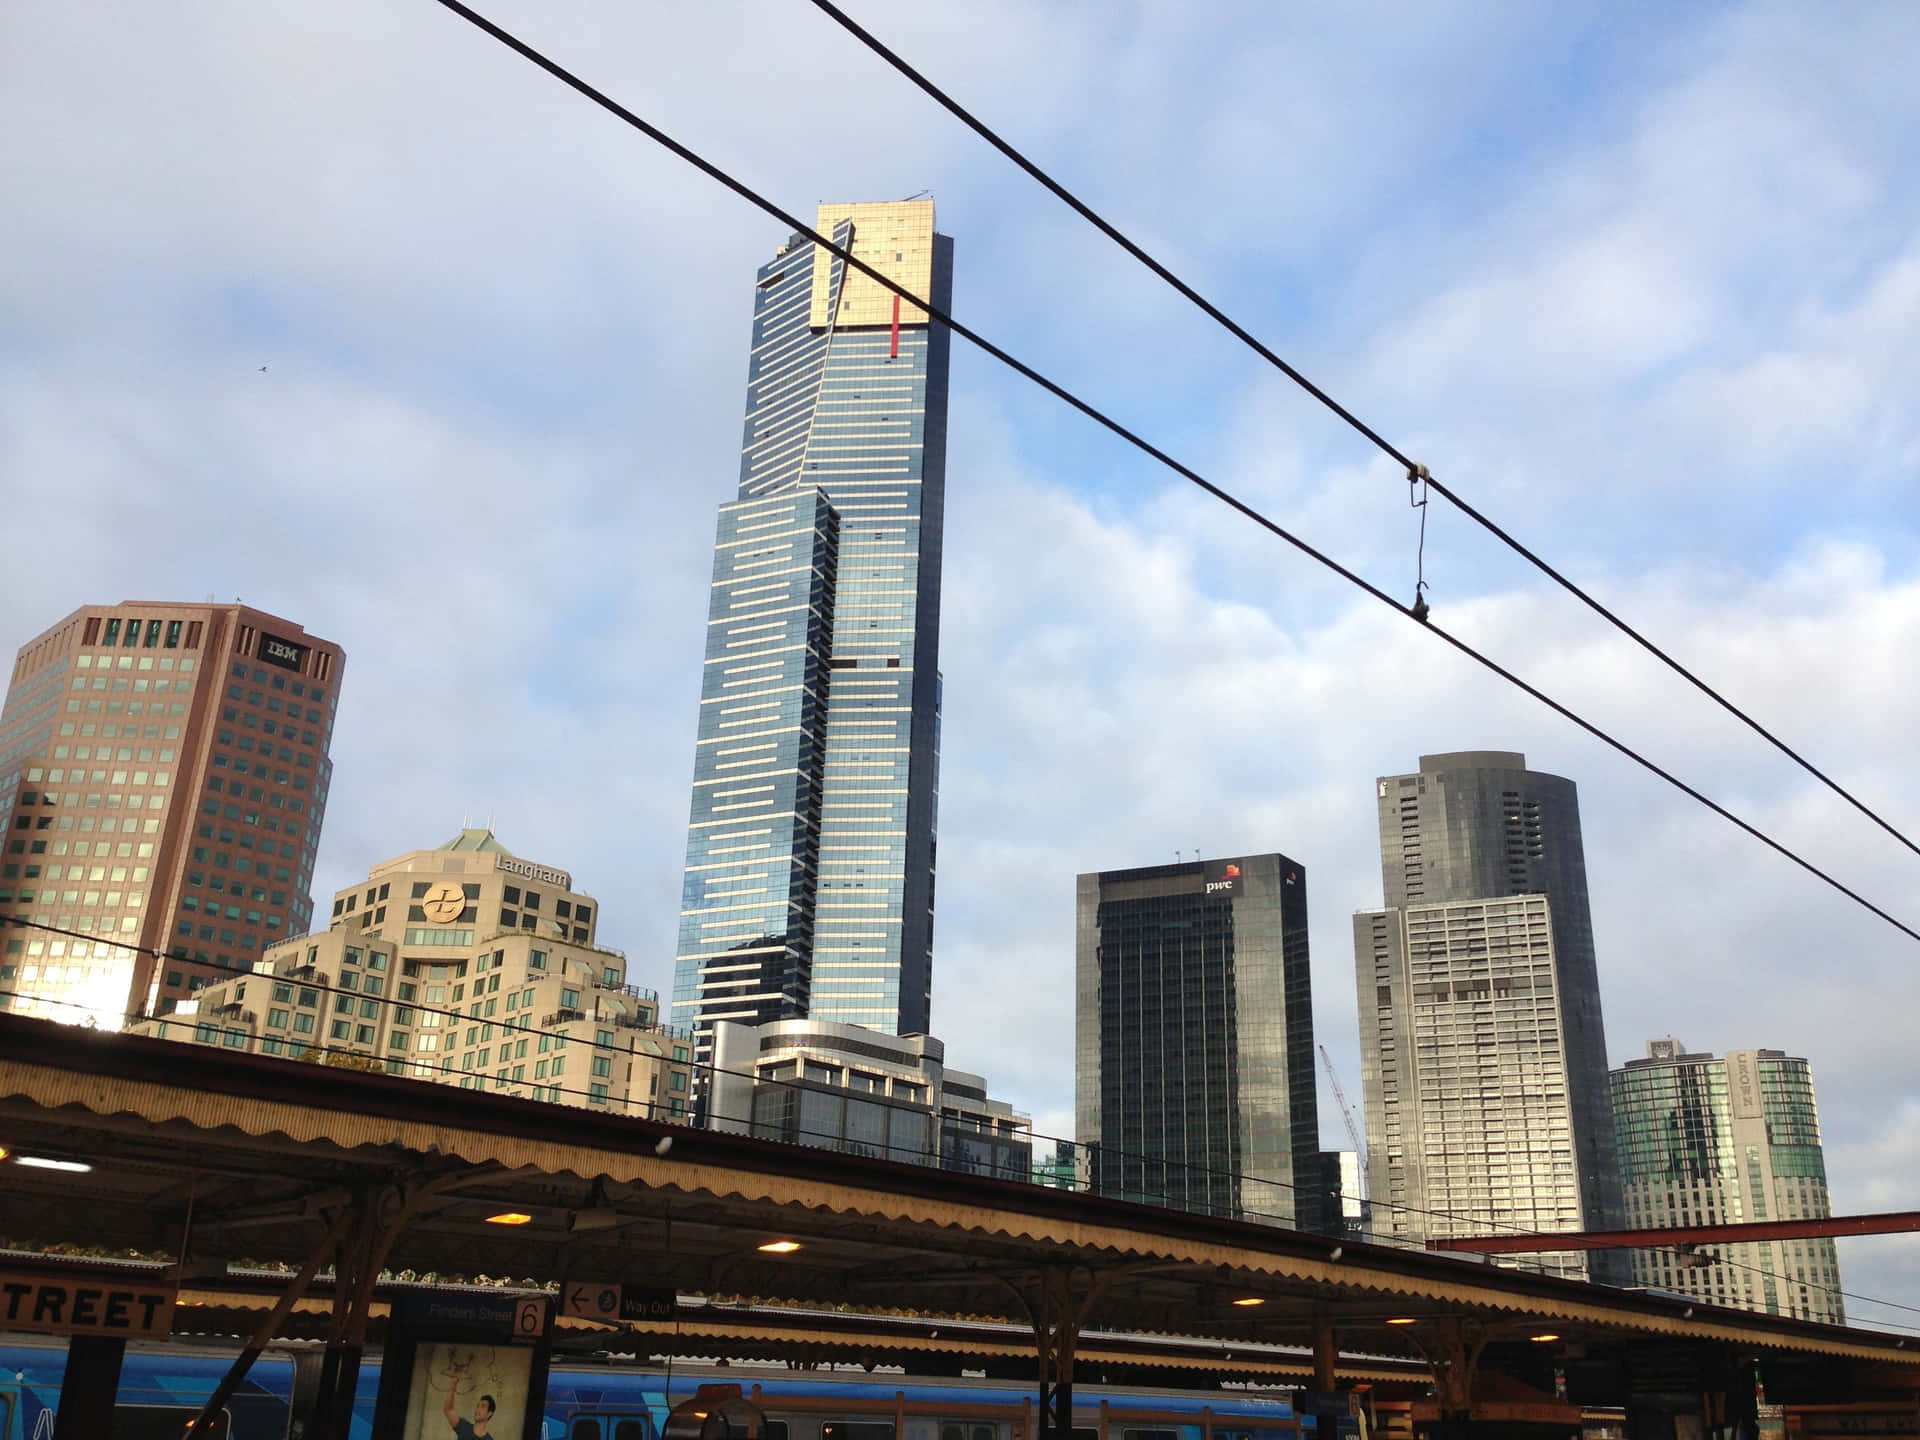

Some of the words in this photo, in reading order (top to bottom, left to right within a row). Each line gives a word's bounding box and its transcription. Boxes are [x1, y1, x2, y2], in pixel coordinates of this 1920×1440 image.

[267, 641, 298, 662] IBM
[496, 853, 567, 886] Langham
[1206, 881, 1233, 894] pwc
[1737, 1054, 1753, 1106] CROWN
[3, 1283, 165, 1330] TREET
[521, 1304, 537, 1333] 6
